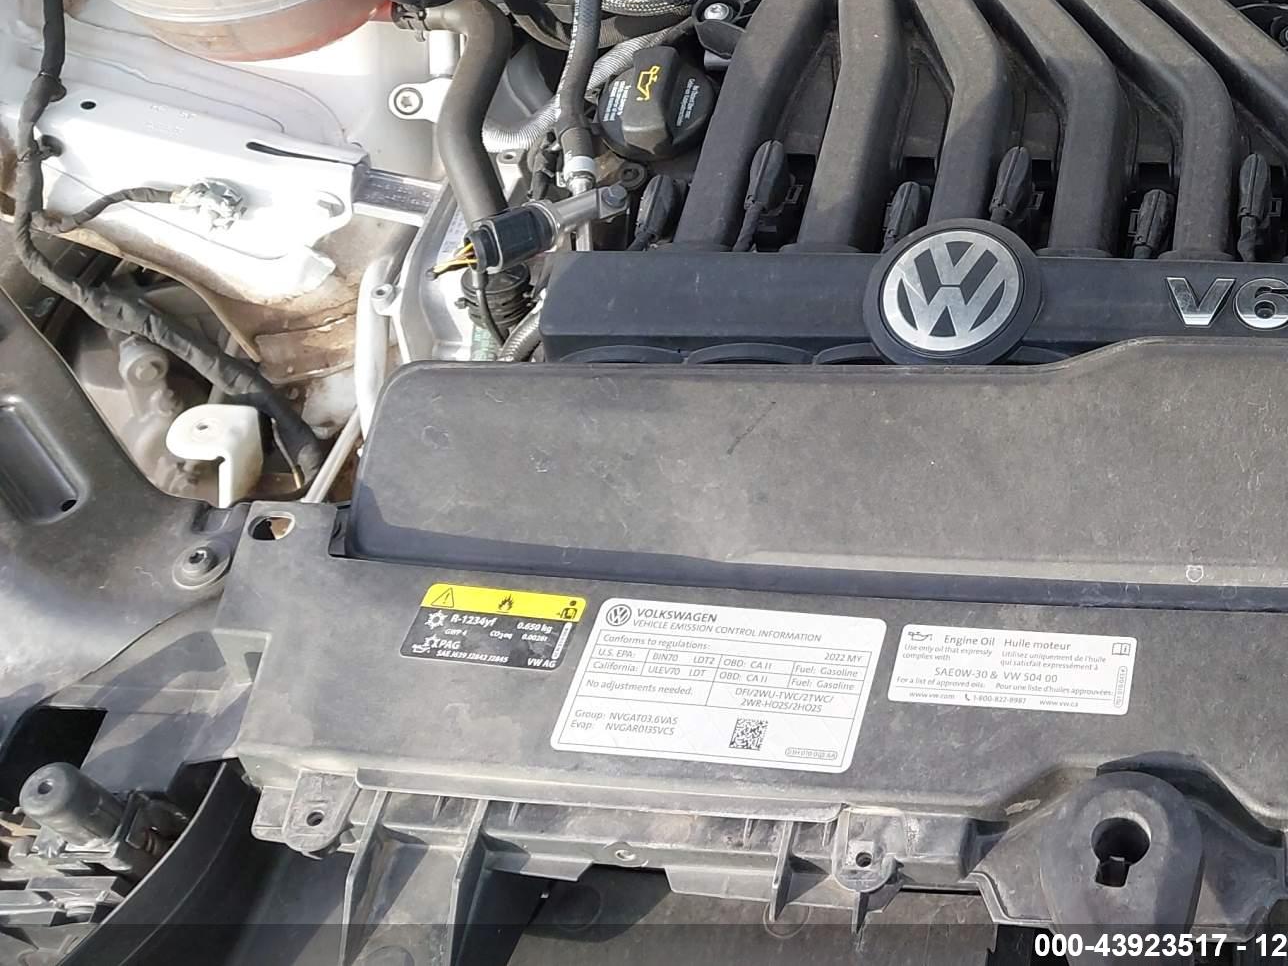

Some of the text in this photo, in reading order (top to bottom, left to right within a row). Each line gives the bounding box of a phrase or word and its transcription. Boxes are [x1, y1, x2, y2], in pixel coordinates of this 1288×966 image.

[450, 614, 497, 627] R-1234yf
[636, 608, 717, 622] VOLKSWAGEN
[541, 623, 553, 634] kg
[633, 619, 822, 642] VEHICLE EMISSION CONTROL INFORMATION
[438, 639, 460, 650] PAG
[603, 634, 711, 650] Conforms to regulations:
[944, 634, 996, 646] Engine Oil
[1004, 639, 1071, 650] Huile moteur
[598, 648, 635, 658] U.S. EPA:
[652, 652, 678, 662] BIN70
[824, 652, 862, 663] 2022 MY
[528, 658, 556, 668] VW AG
[693, 656, 715, 664] LDT2
[724, 658, 746, 668] OBD:
[750, 660, 763, 669] CA
[592, 661, 638, 672] California:
[648, 665, 680, 675] ULEV70
[795, 665, 858, 678] Fuel: Gasoline
[688, 669, 706, 677] LDT
[720, 671, 742, 680] OBD:
[746, 674, 758, 682] CA
[1003, 672, 1020, 680] VW
[1024, 674, 1042, 682] 504
[1045, 675, 1058, 683] 00
[585, 679, 693, 695] No adjustments needed.
[792, 678, 855, 690] Fuel: Gasoline
[575, 709, 605, 720] Group:
